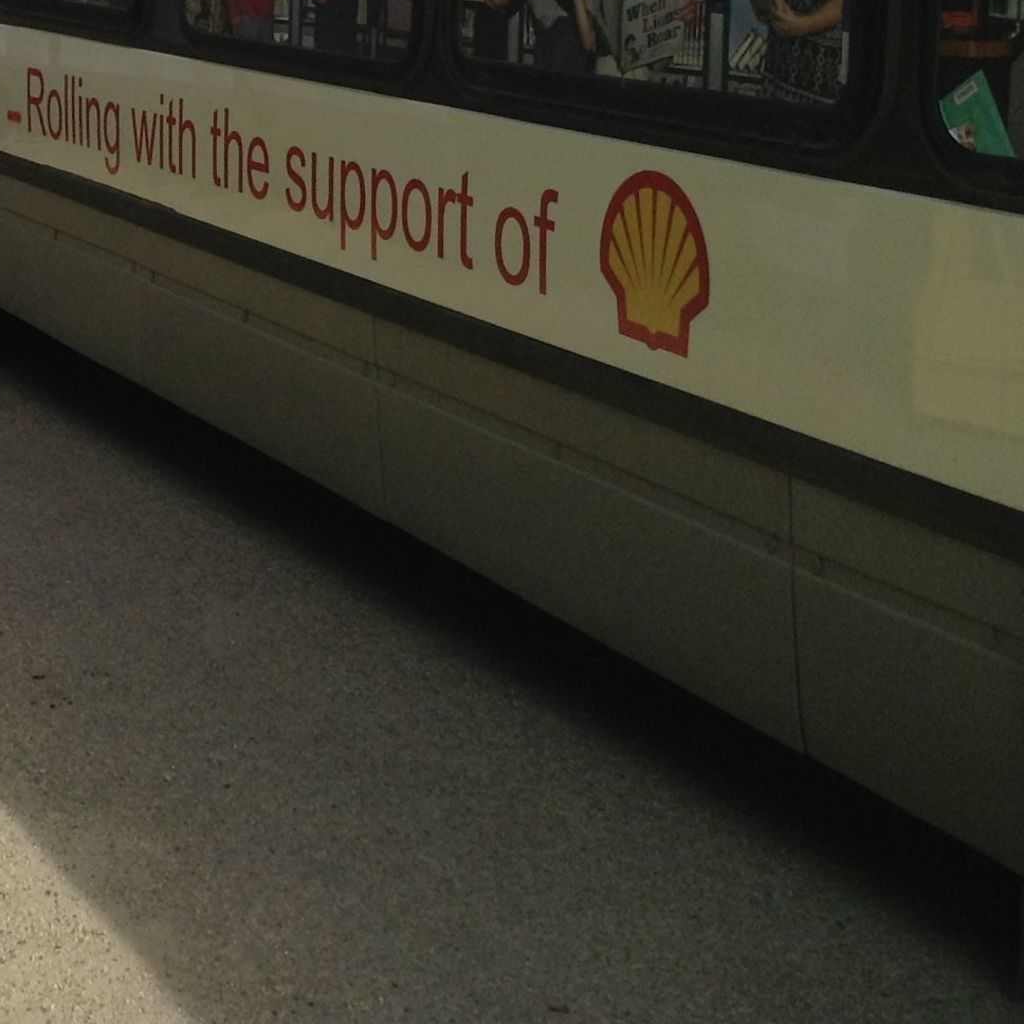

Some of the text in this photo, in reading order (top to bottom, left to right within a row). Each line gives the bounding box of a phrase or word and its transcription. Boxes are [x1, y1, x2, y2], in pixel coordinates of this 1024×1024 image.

[626, 0, 667, 22] When
[26, 66, 559, 295] Rolling with the support of
